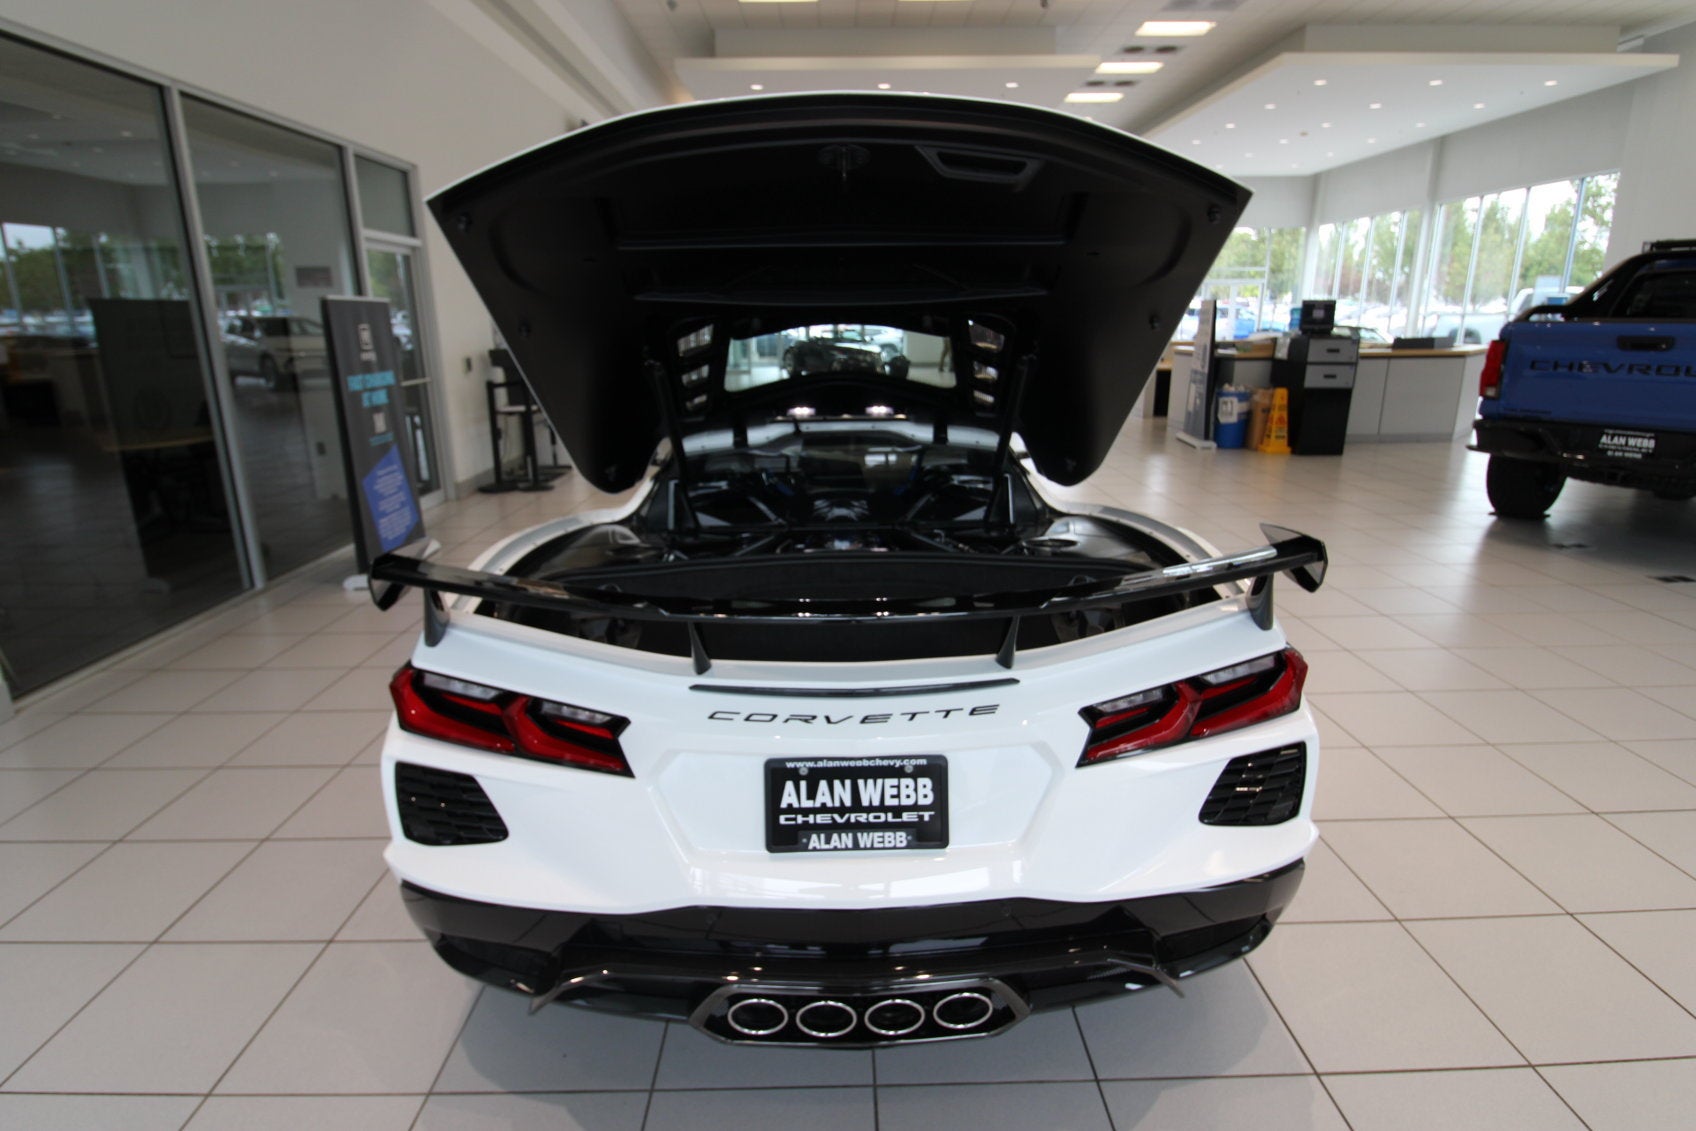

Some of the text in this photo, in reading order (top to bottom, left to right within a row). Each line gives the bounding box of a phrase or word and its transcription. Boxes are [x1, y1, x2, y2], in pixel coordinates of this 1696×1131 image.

[1600, 433, 1626, 446] ALAN
[1628, 436, 1655, 449] WEBB
[708, 703, 1000, 725] CORVETTE
[786, 757, 927, 768] www.alanwebbchevy.com
[780, 777, 934, 808] ALAN WEBB
[779, 811, 935, 825] CHEVROLET
[808, 831, 907, 849] ALAN WEBB
